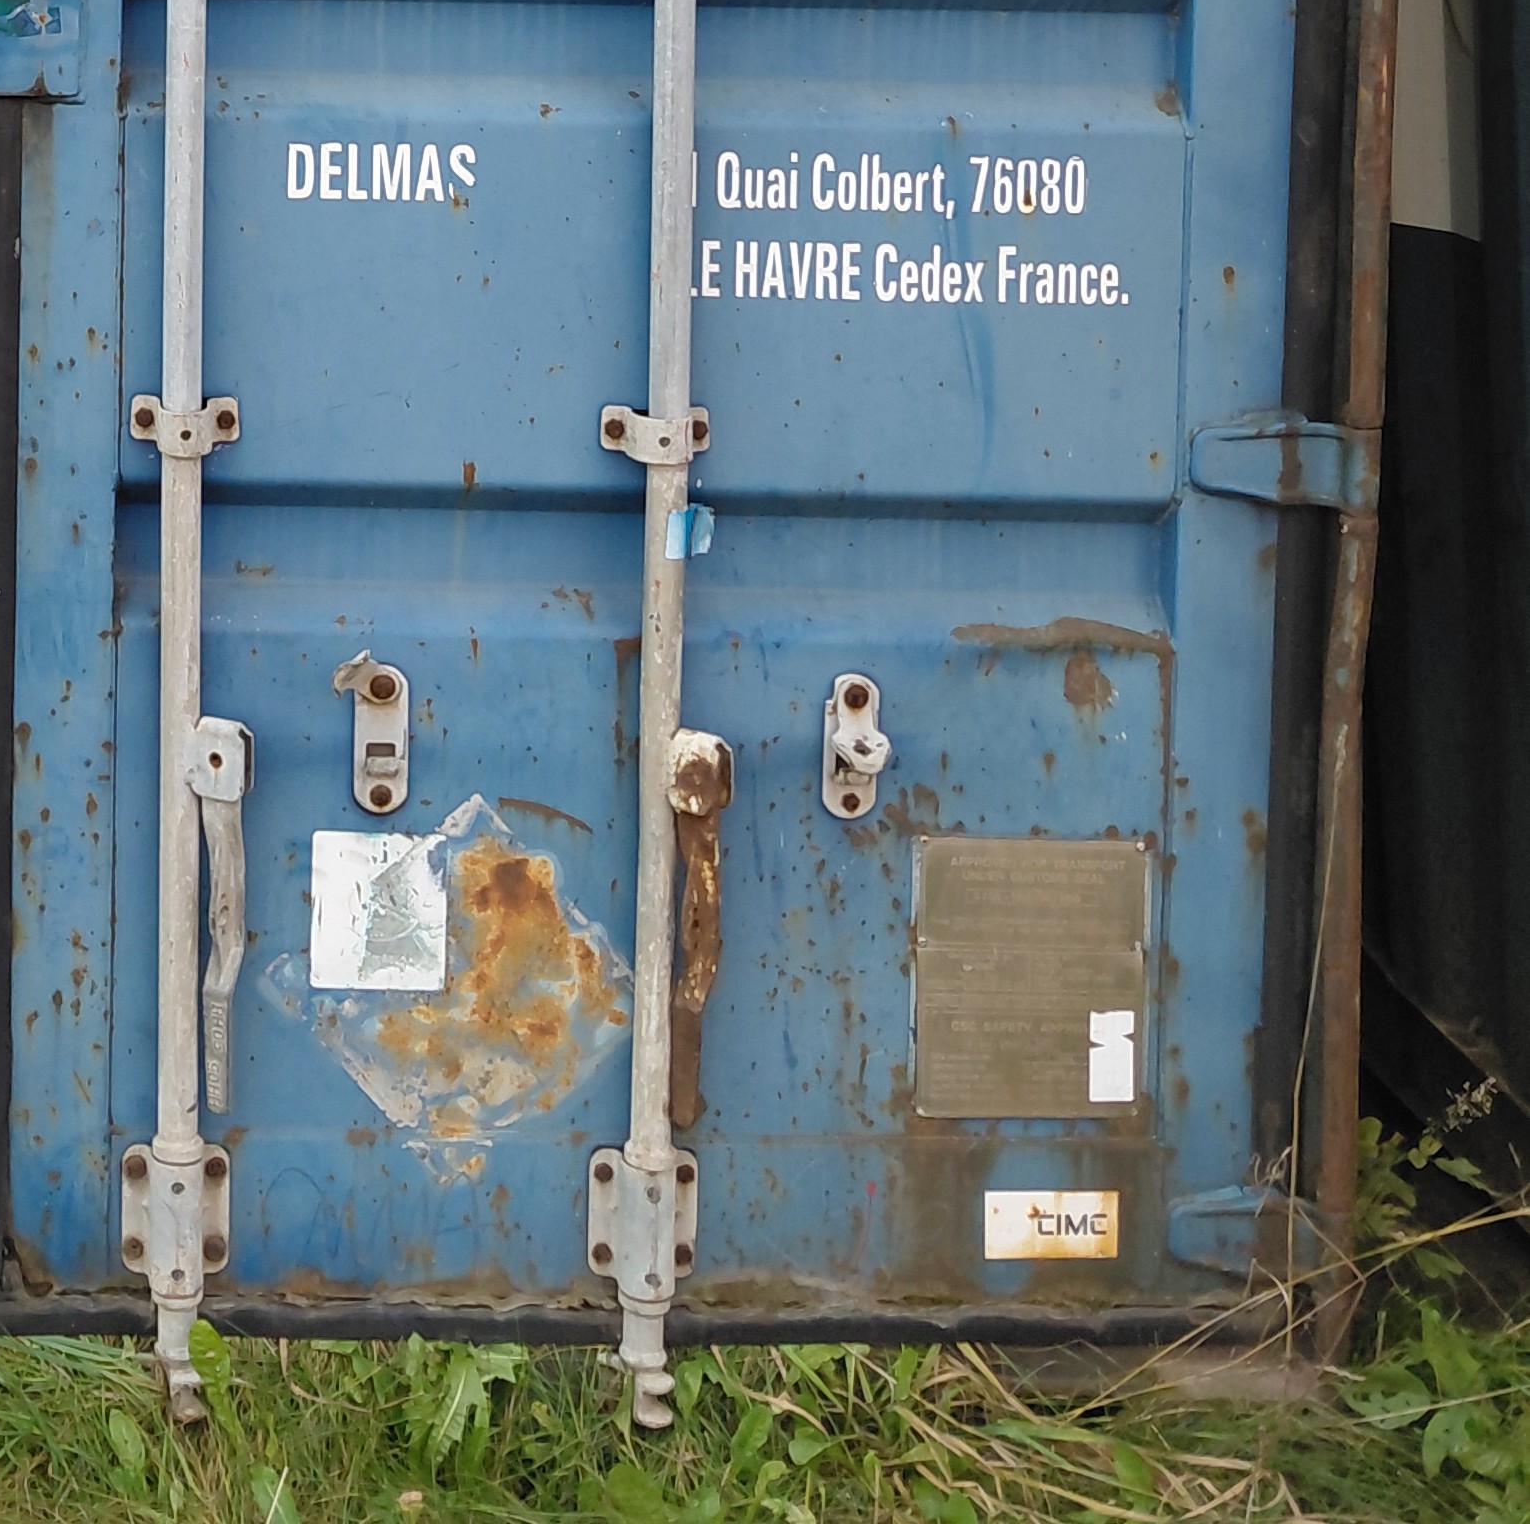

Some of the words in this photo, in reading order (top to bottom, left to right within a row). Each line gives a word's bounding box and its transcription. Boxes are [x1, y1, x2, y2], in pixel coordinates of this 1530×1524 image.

[287, 142, 476, 202] DELMAS
[717, 151, 799, 210] Quai
[812, 152, 955, 220] Colbert,
[969, 156, 1088, 214] 76080
[690, 240, 721, 298] E
[734, 241, 861, 300] HAVRE
[874, 243, 985, 303] Cedex
[998, 245, 1129, 305] France.
[1037, 1213, 1108, 1236] CIMC
